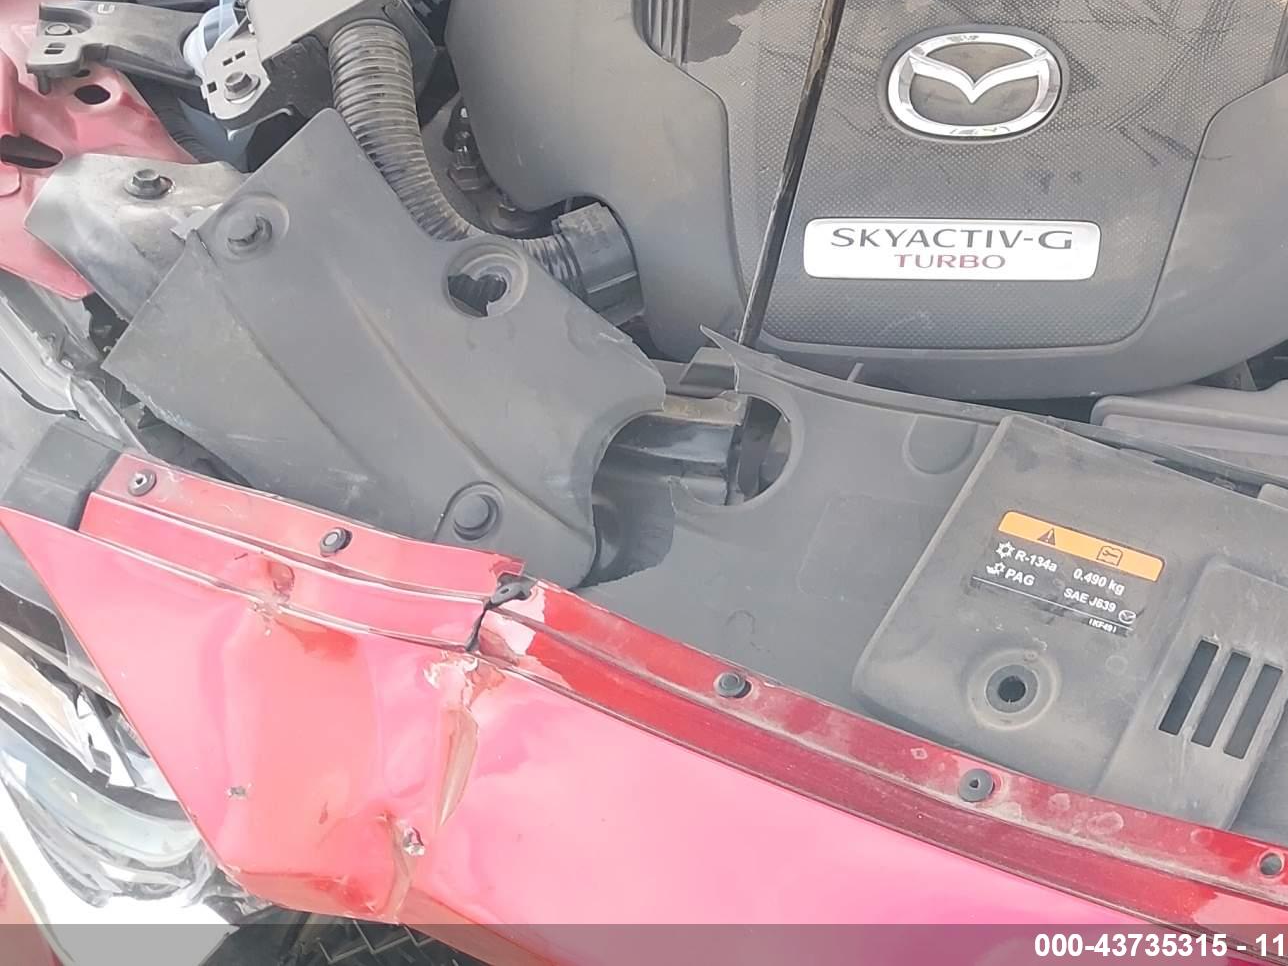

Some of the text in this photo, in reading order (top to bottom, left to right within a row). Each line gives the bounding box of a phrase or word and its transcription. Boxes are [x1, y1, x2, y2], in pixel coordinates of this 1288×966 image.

[830, 227, 1073, 250] SKYACTIV-G
[894, 253, 1006, 269] TURBO
[1014, 550, 1126, 596] R-134a 0.490 kg
[1004, 568, 1117, 612] PAG SAE J639
